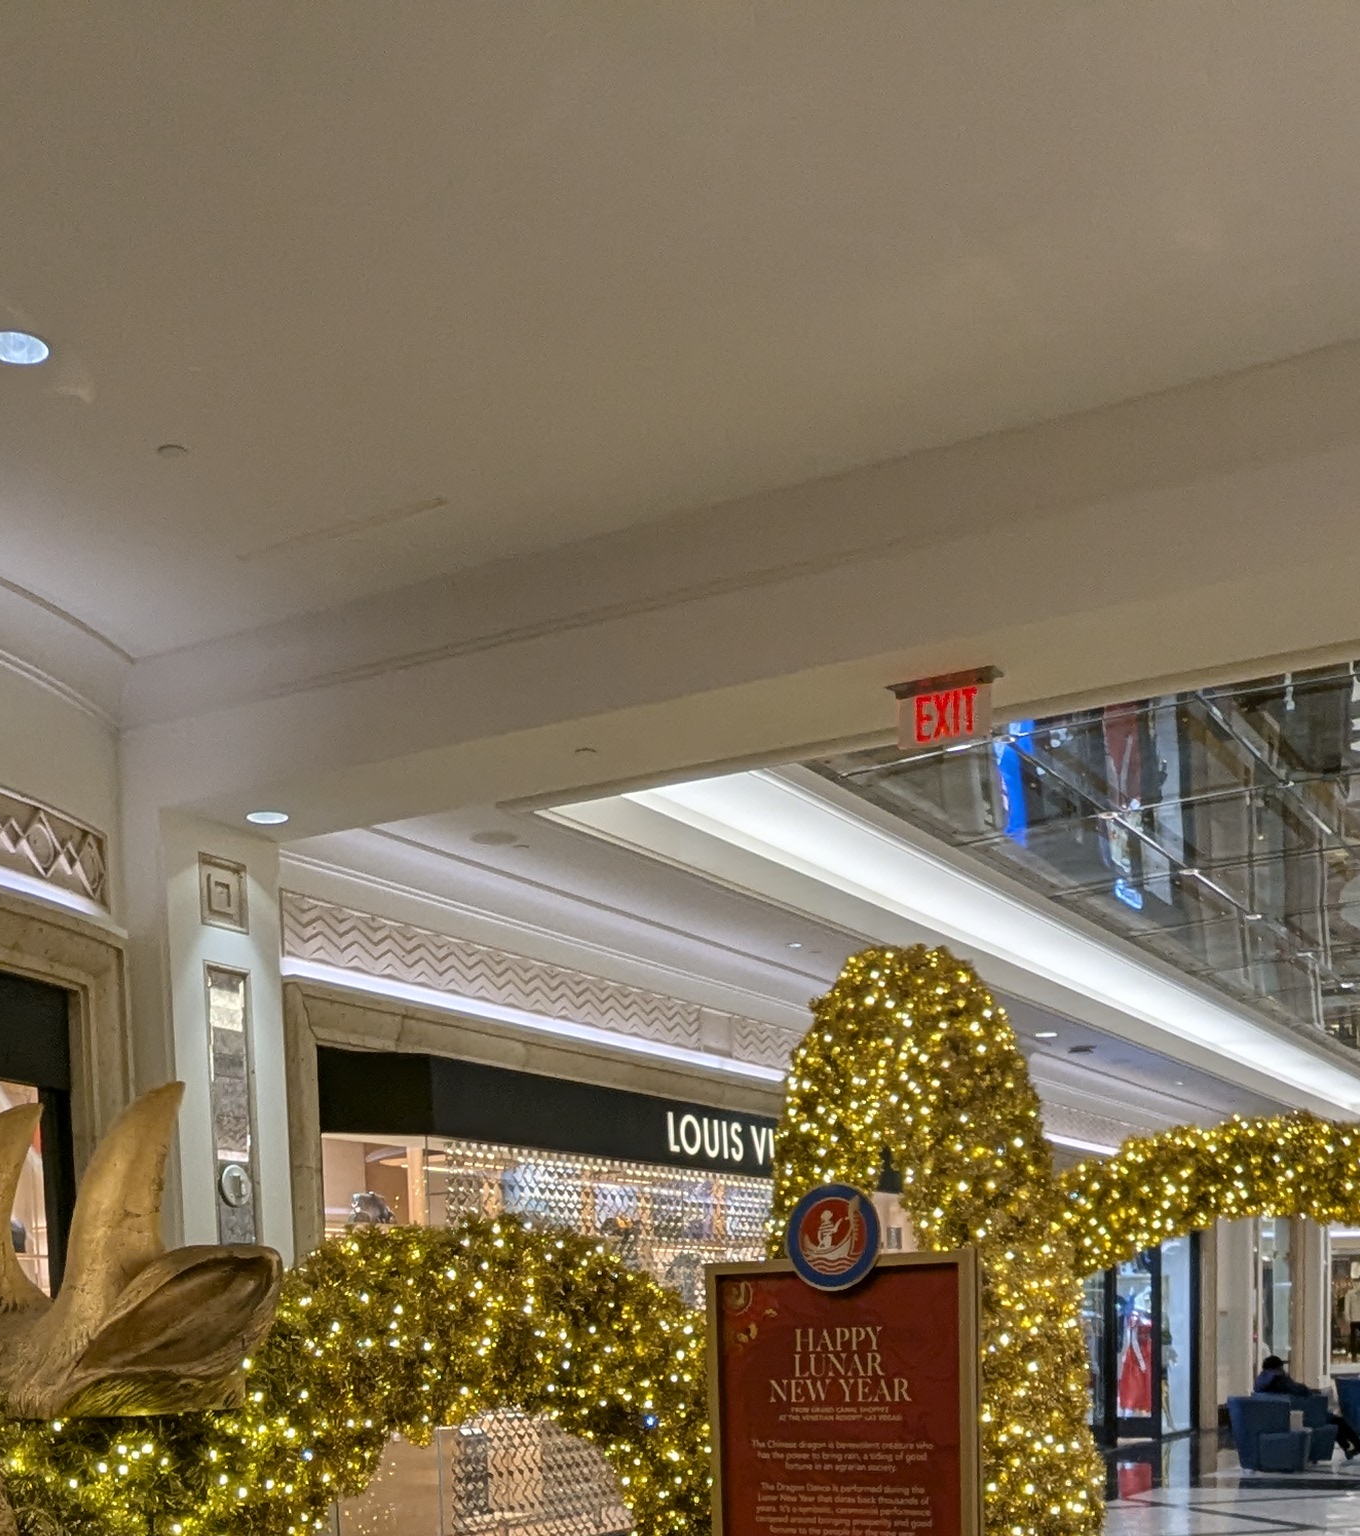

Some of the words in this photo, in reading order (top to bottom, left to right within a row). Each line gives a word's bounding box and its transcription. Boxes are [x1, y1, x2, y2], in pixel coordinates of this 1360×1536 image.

[915, 686, 977, 742] EXIT
[667, 1111, 744, 1162] LOUIS
[795, 1326, 883, 1352] HAPPY
[794, 1352, 885, 1378] LUNAR
[769, 1379, 832, 1403] NEW
[839, 1377, 913, 1402] YEAR
